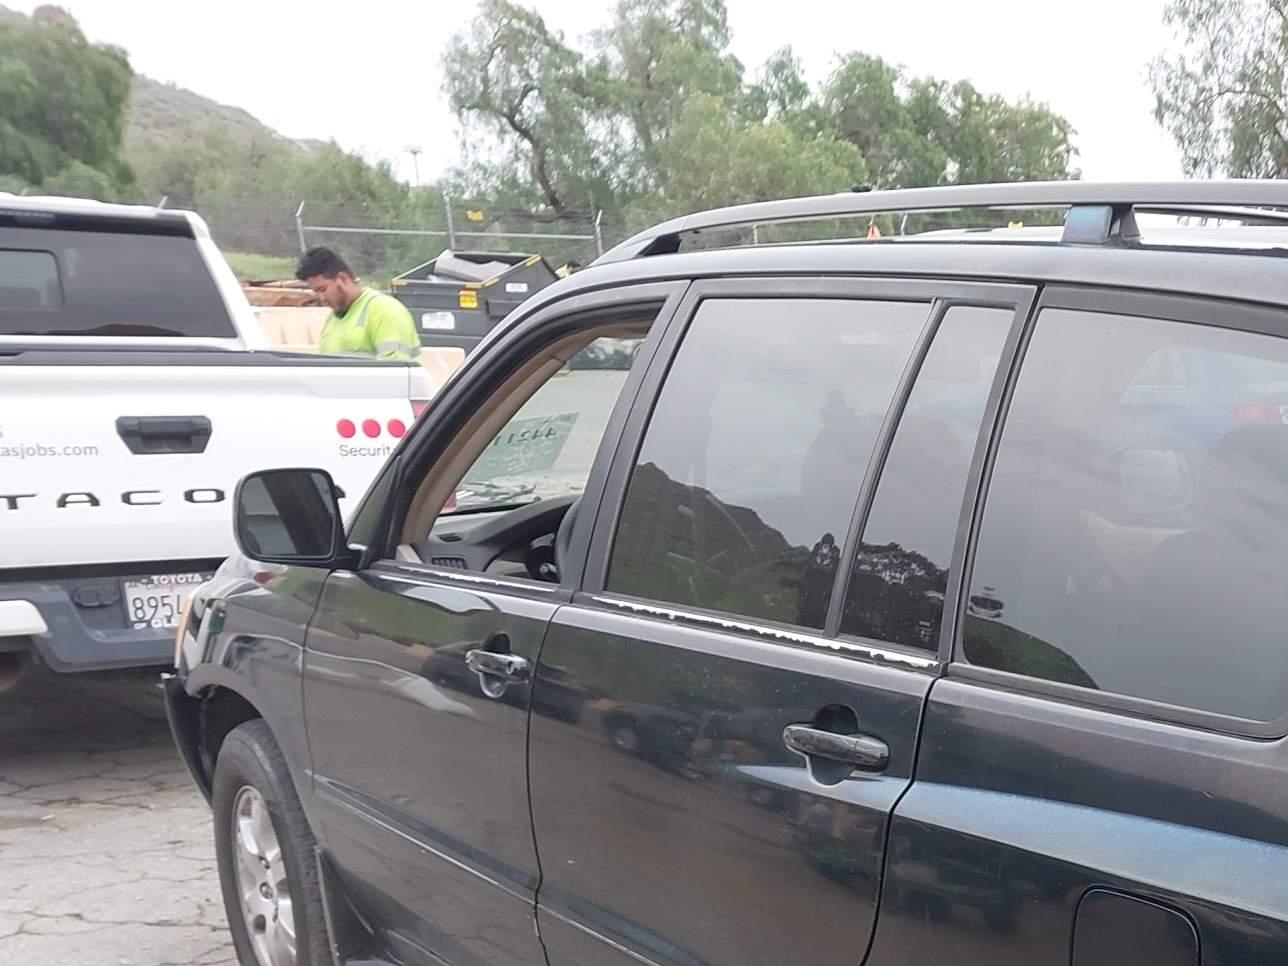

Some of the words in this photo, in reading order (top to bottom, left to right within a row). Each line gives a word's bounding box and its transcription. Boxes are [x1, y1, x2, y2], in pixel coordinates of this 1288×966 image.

[338, 443, 395, 457] Securit
[0, 485, 346, 511] TACO
[150, 573, 203, 585] TOYOTA
